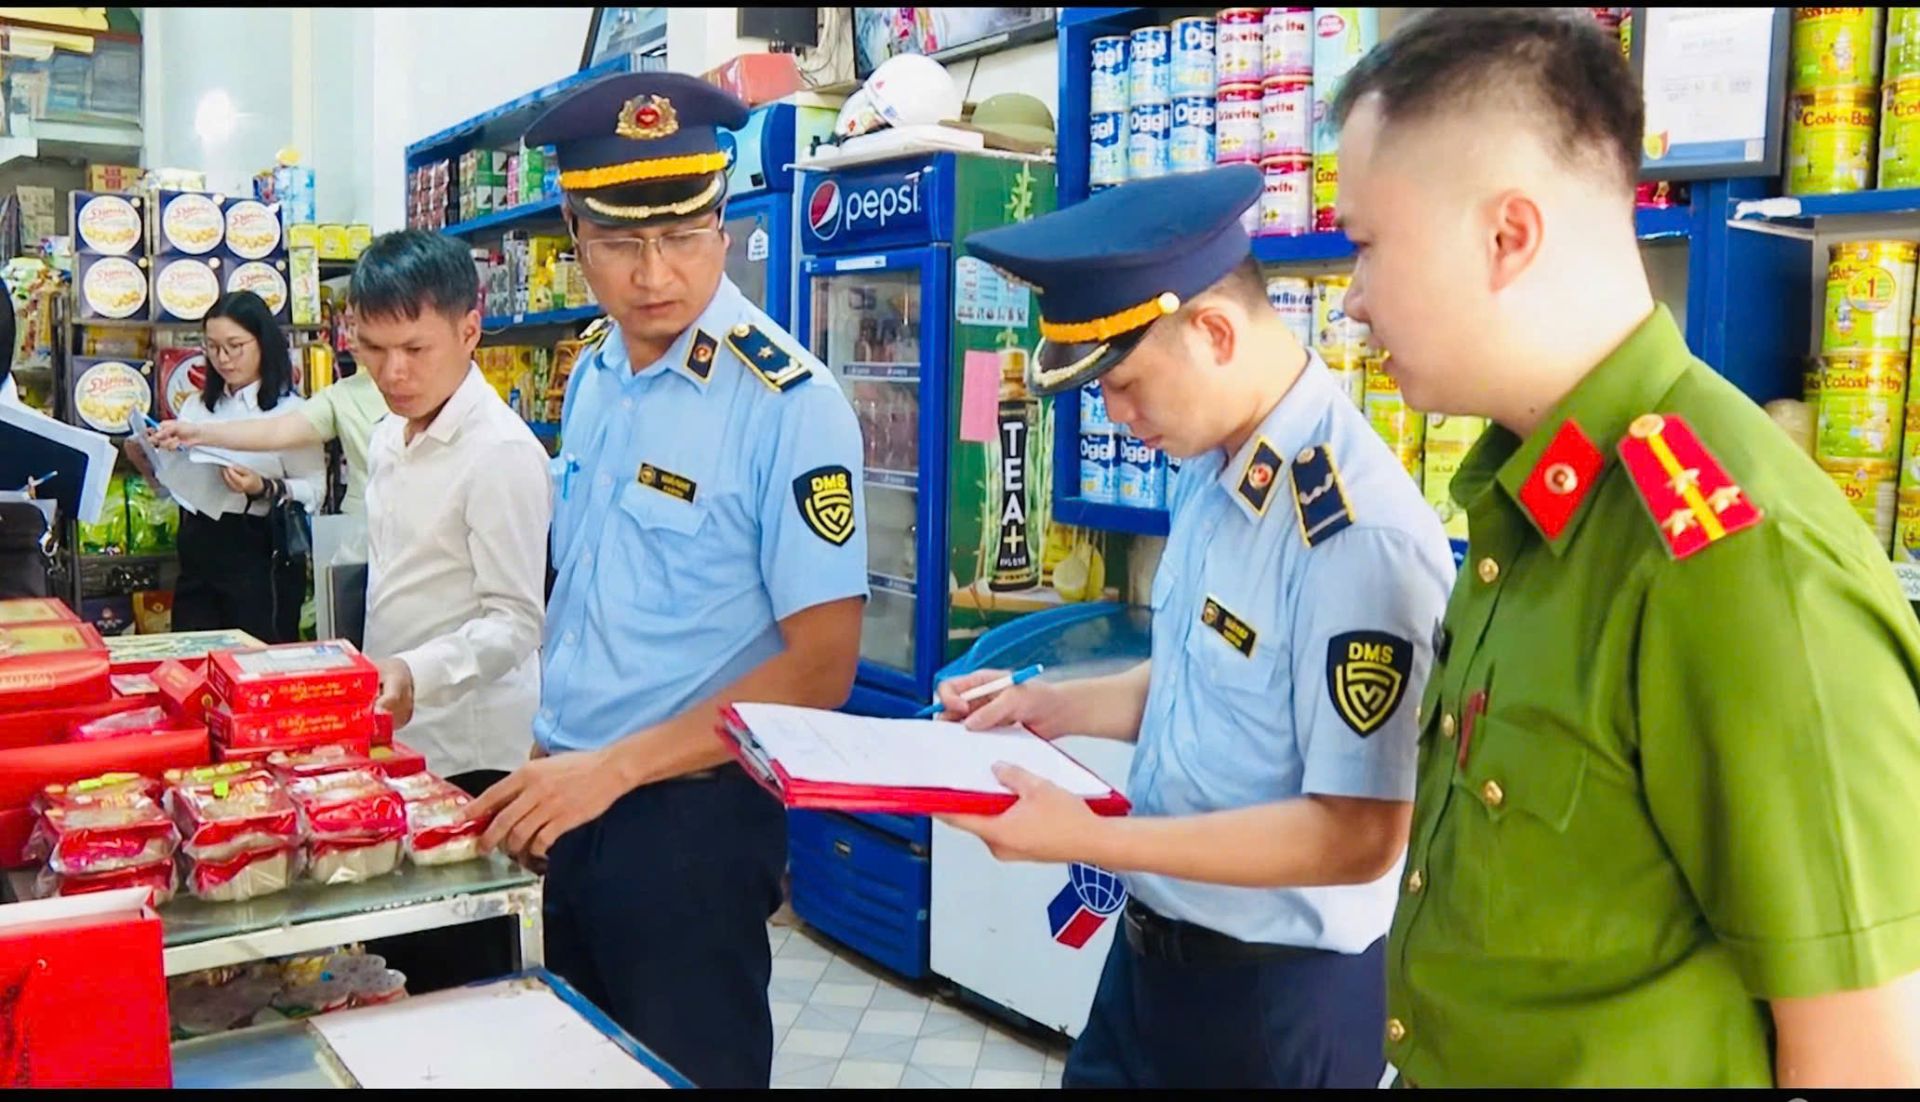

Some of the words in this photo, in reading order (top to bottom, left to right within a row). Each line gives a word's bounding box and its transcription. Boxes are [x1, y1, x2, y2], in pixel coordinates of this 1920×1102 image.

[1130, 107, 1170, 133] Oggi
[1174, 103, 1215, 127] Ogg
[845, 171, 919, 230] pepsi
[1081, 437, 1116, 461] Oggi
[1121, 442, 1156, 463] Oggi
[811, 473, 847, 492] DMS
[1348, 641, 1394, 663] DMS
